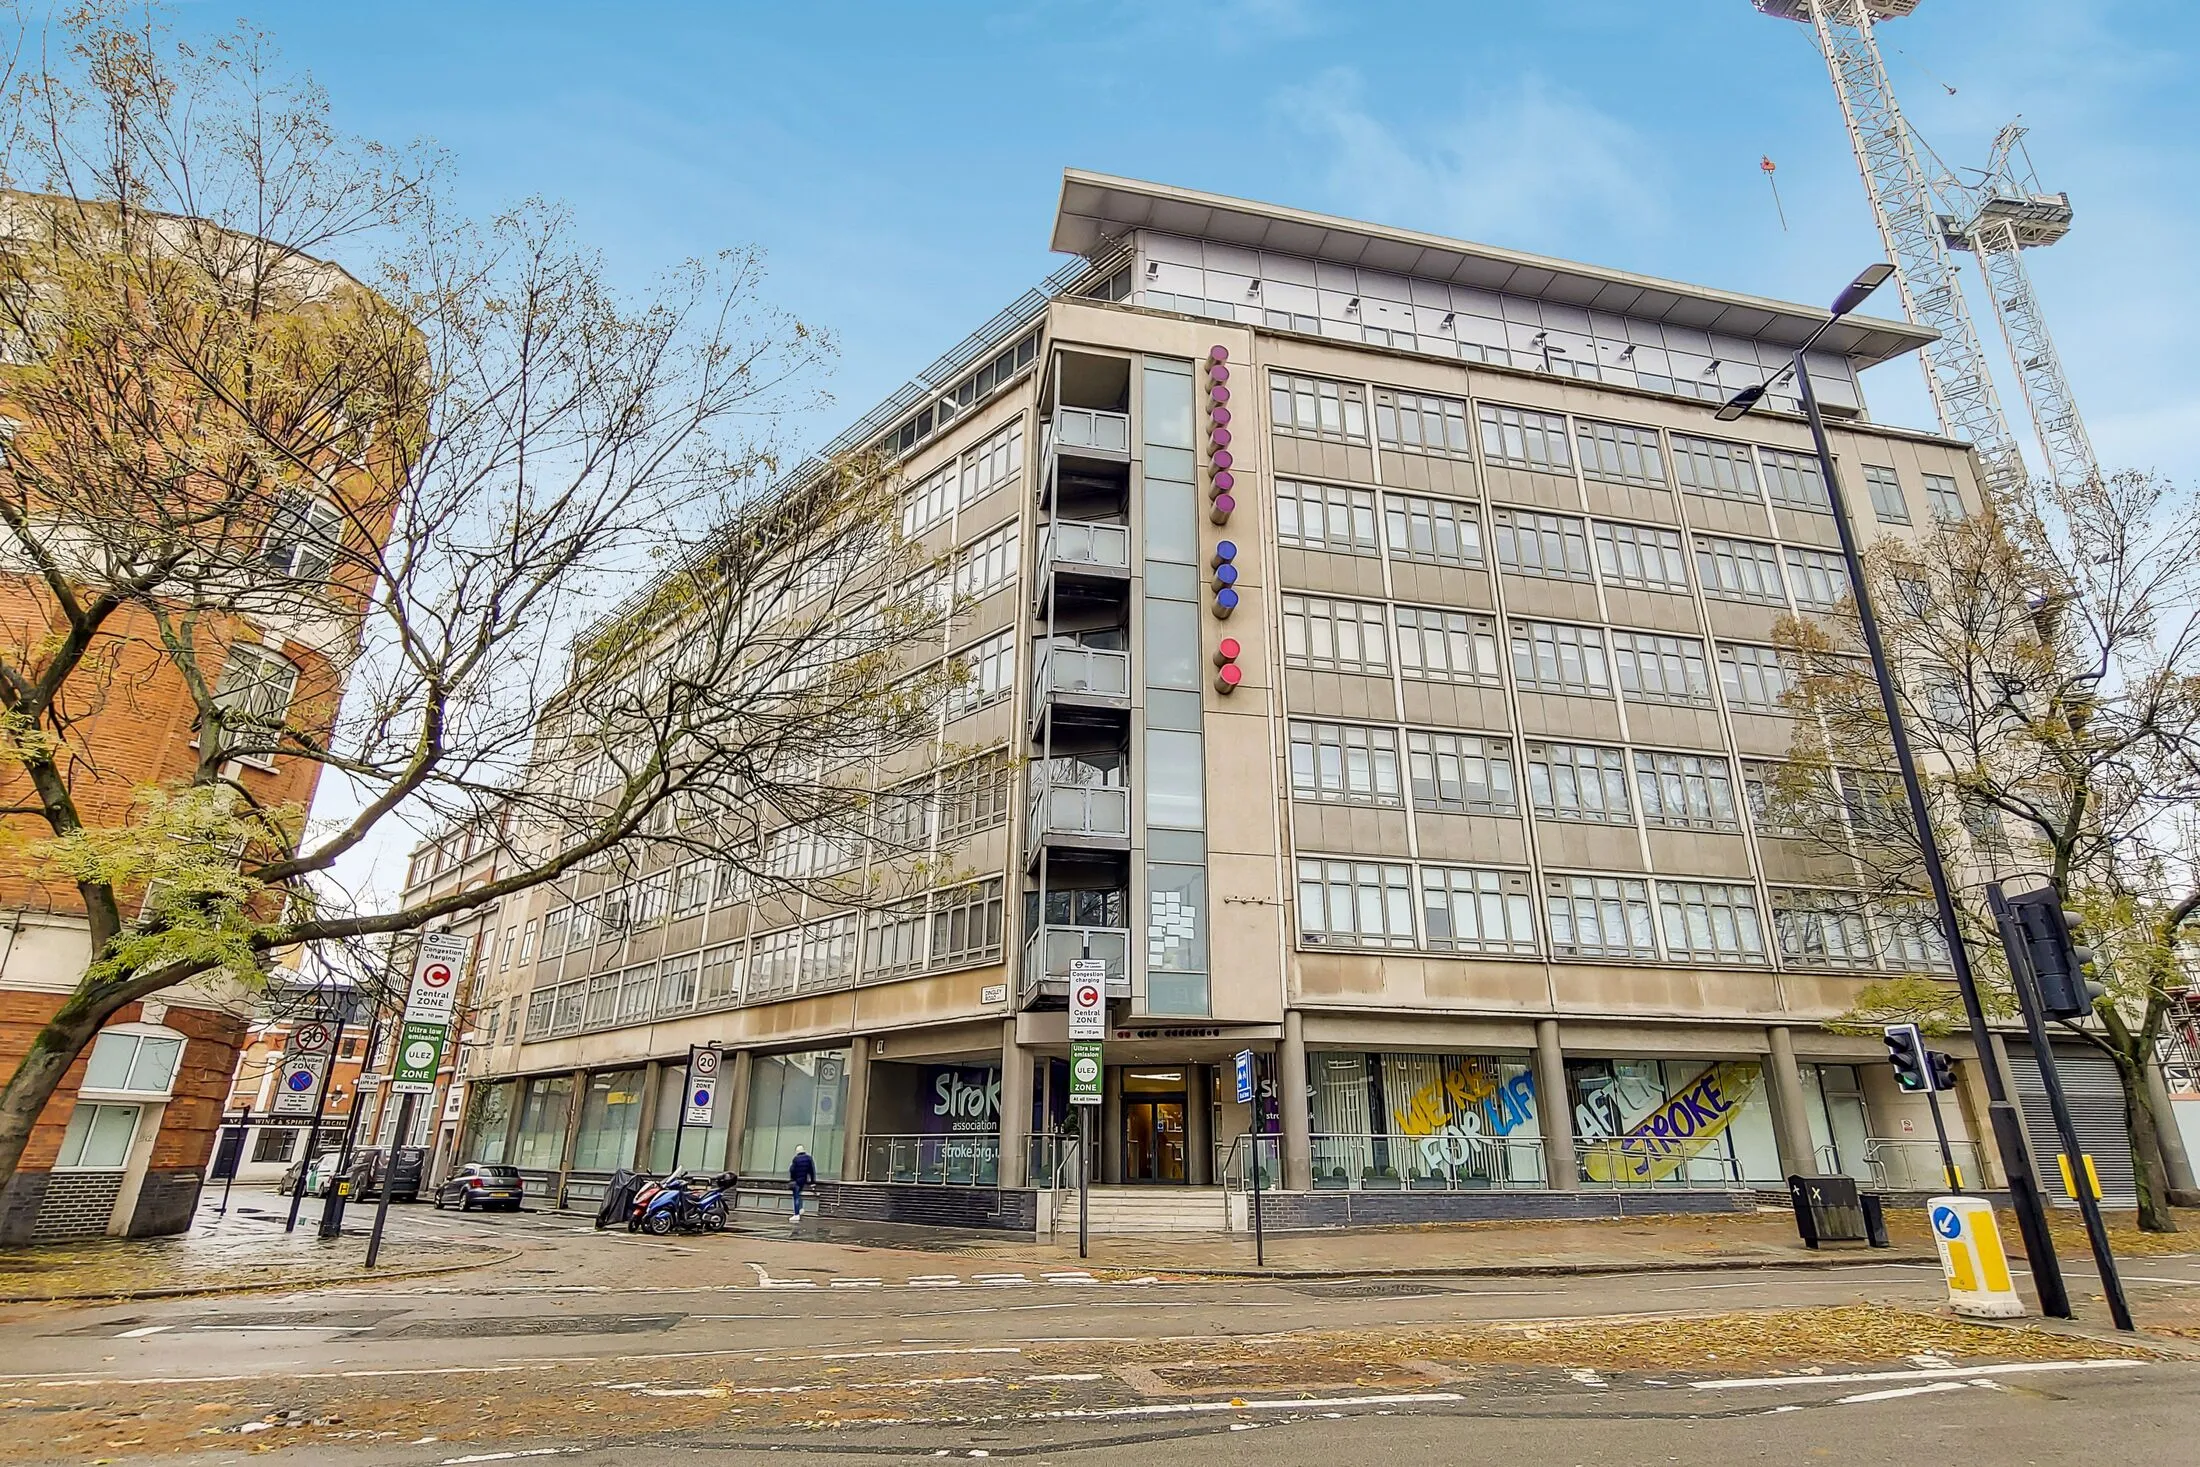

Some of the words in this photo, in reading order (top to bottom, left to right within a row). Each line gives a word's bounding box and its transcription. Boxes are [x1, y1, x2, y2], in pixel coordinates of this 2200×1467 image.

[423, 945, 462, 956] Congestion
[426, 953, 456, 962] charging
[416, 988, 449, 999] Central
[417, 998, 444, 1007] ZONE
[408, 1026, 428, 1034] Ultra
[429, 1027, 443, 1035] low
[408, 1033, 439, 1042] emission
[408, 1051, 432, 1060] ULEZ
[700, 1057, 714, 1068] 20
[401, 1069, 430, 1079] ZONE
[934, 1067, 1000, 1118] Strok
[1074, 1083, 1097, 1092] ZONE
[320, 1119, 347, 1127] ERCHA
[952, 1120, 997, 1131] association
[1621, 1073, 1736, 1176] STROKE
[1419, 1111, 1495, 1173] FOR
